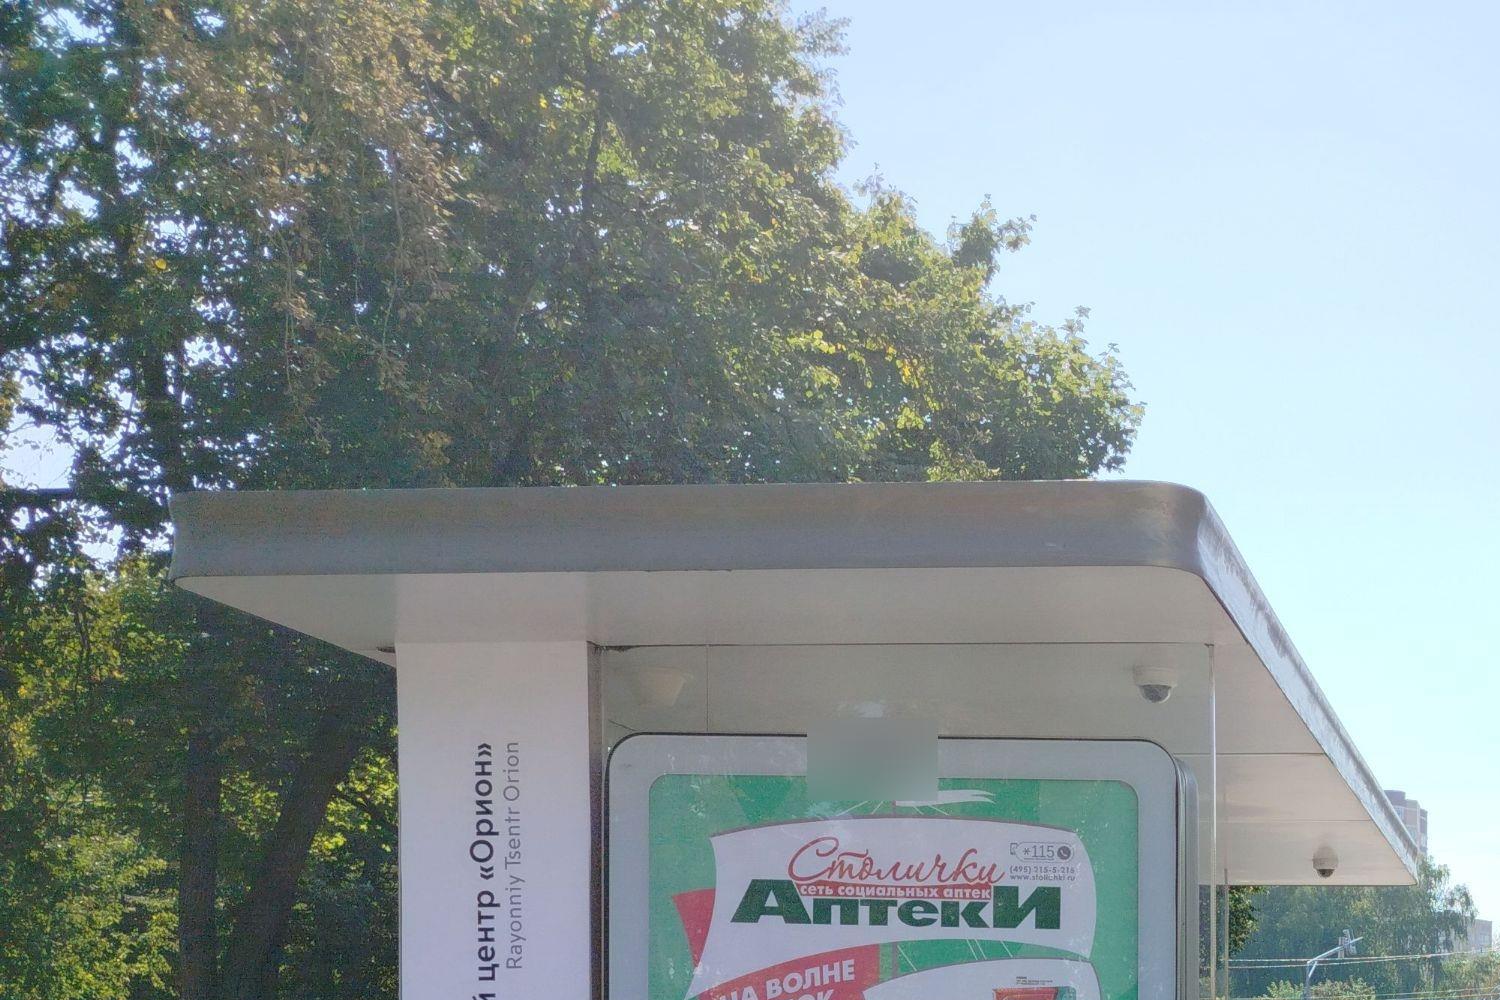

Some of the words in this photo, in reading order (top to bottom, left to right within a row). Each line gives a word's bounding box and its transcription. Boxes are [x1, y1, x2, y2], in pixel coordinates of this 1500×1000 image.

[503, 741, 521, 802] Orion
[470, 742, 500, 880] «Орион»
[504, 807, 521, 870] Tsentr
[787, 836, 1006, 884] Столички
[505, 874, 526, 970] Rayonniy
[799, 885, 833, 896] сеть
[837, 886, 938, 899] социальных
[943, 888, 991, 899] аптек
[477, 889, 501, 983] центр
[766, 959, 856, 1000] ВОЛНЕ
